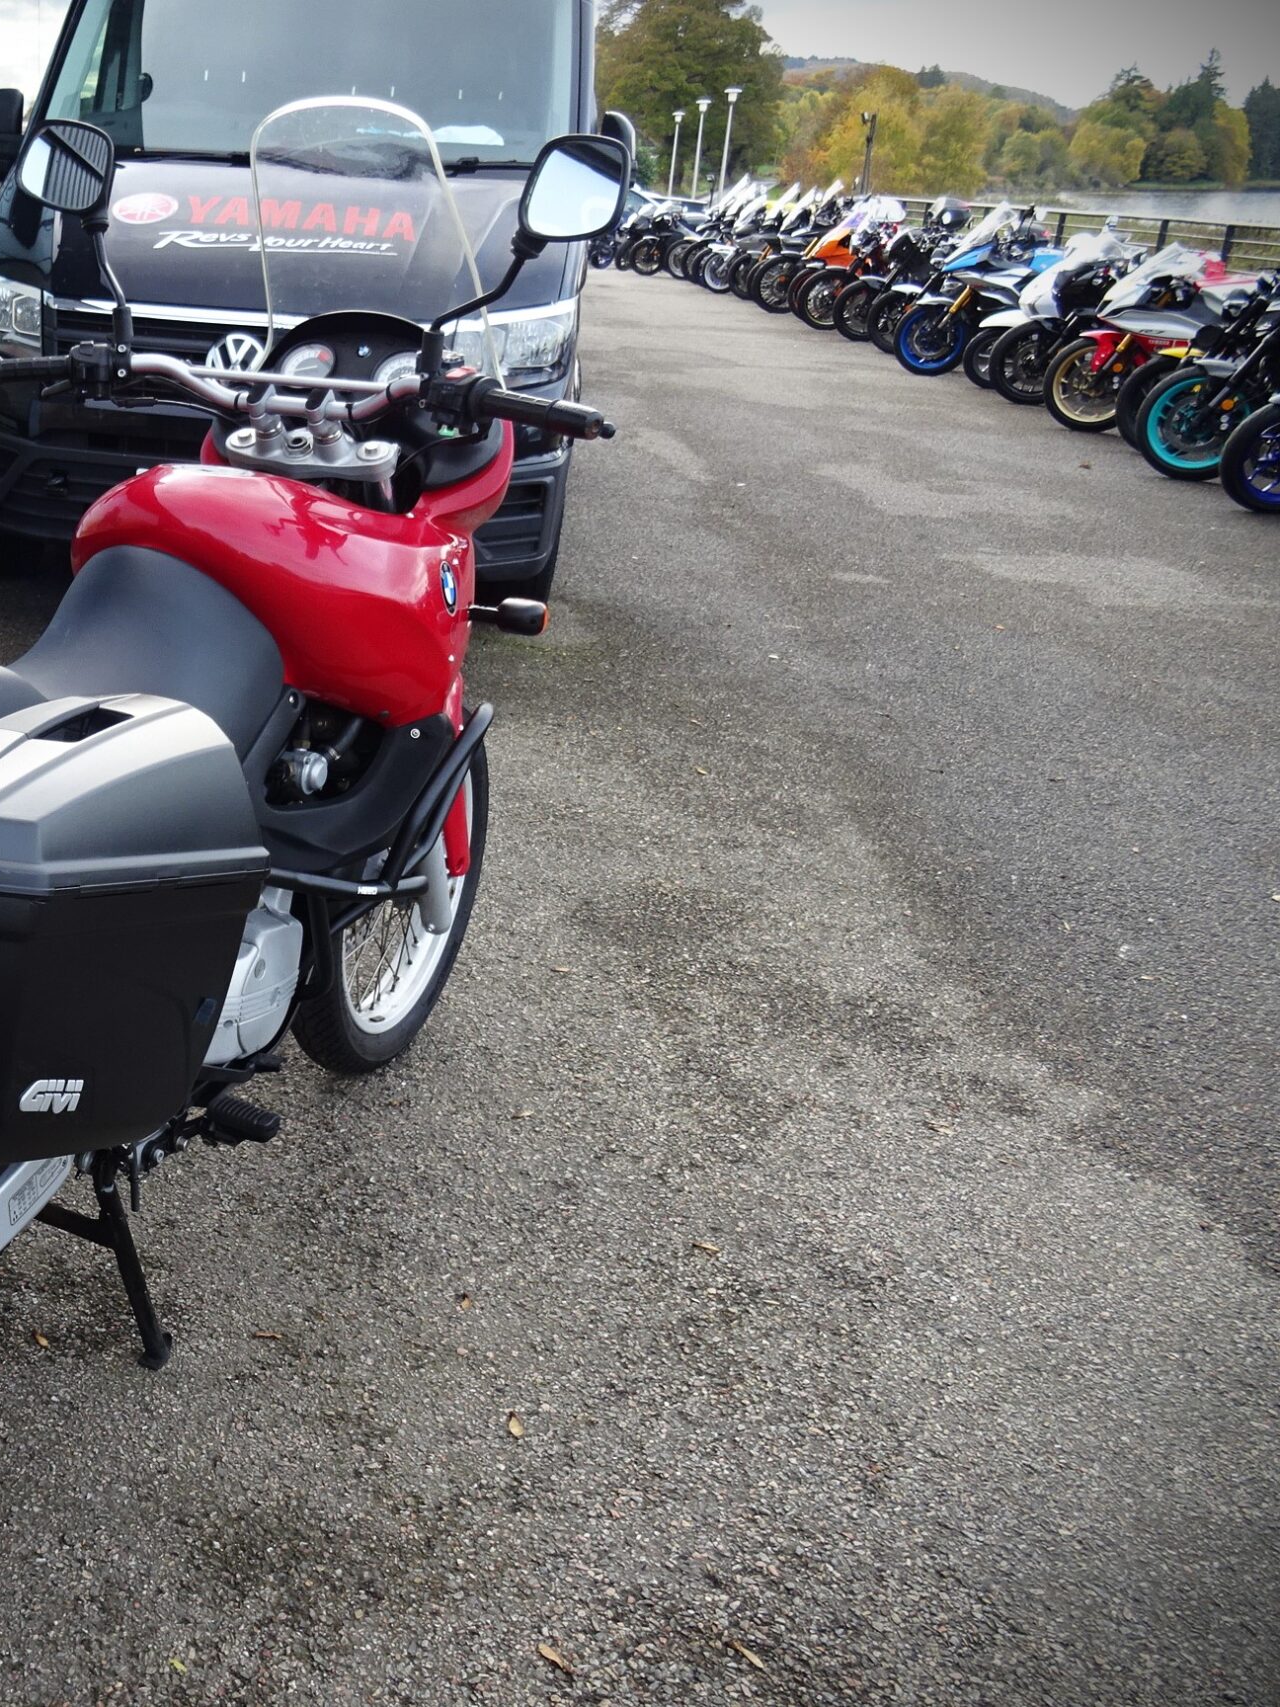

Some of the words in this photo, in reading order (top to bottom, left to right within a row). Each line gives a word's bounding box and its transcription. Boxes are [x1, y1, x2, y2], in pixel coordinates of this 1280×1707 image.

[187, 195, 416, 242] YAMAHA
[153, 230, 252, 249] Revs
[318, 237, 394, 251] Heart
[19, 1079, 84, 1114] GIVI
